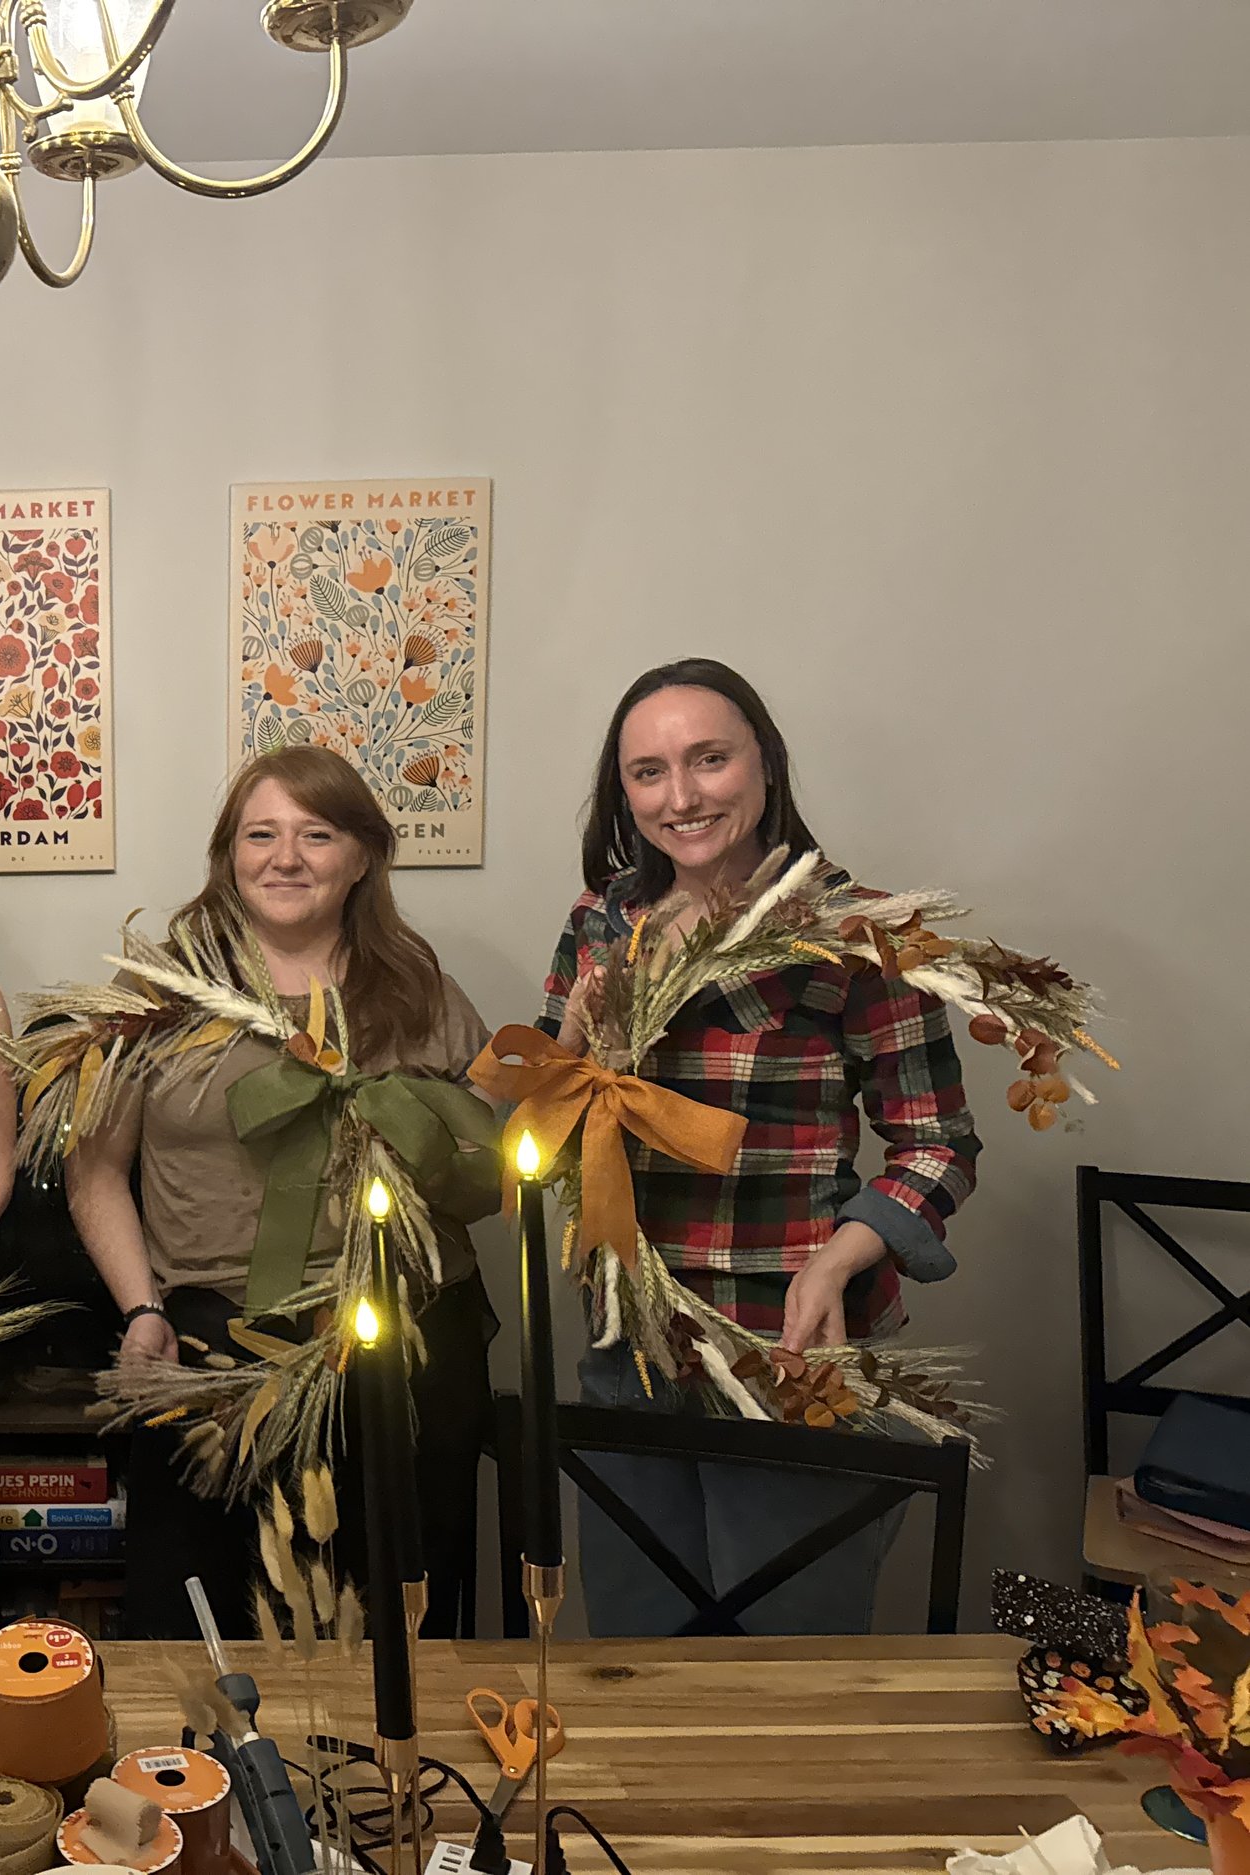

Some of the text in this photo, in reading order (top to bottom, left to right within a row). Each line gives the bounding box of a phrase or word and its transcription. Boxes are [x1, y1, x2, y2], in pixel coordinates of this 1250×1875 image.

[247, 489, 476, 512] FLOWER MARKET
[396, 822, 445, 839] GEN
[29, 1474, 75, 1487] PEPIN
[56, 1659, 78, 1667] YARDS
